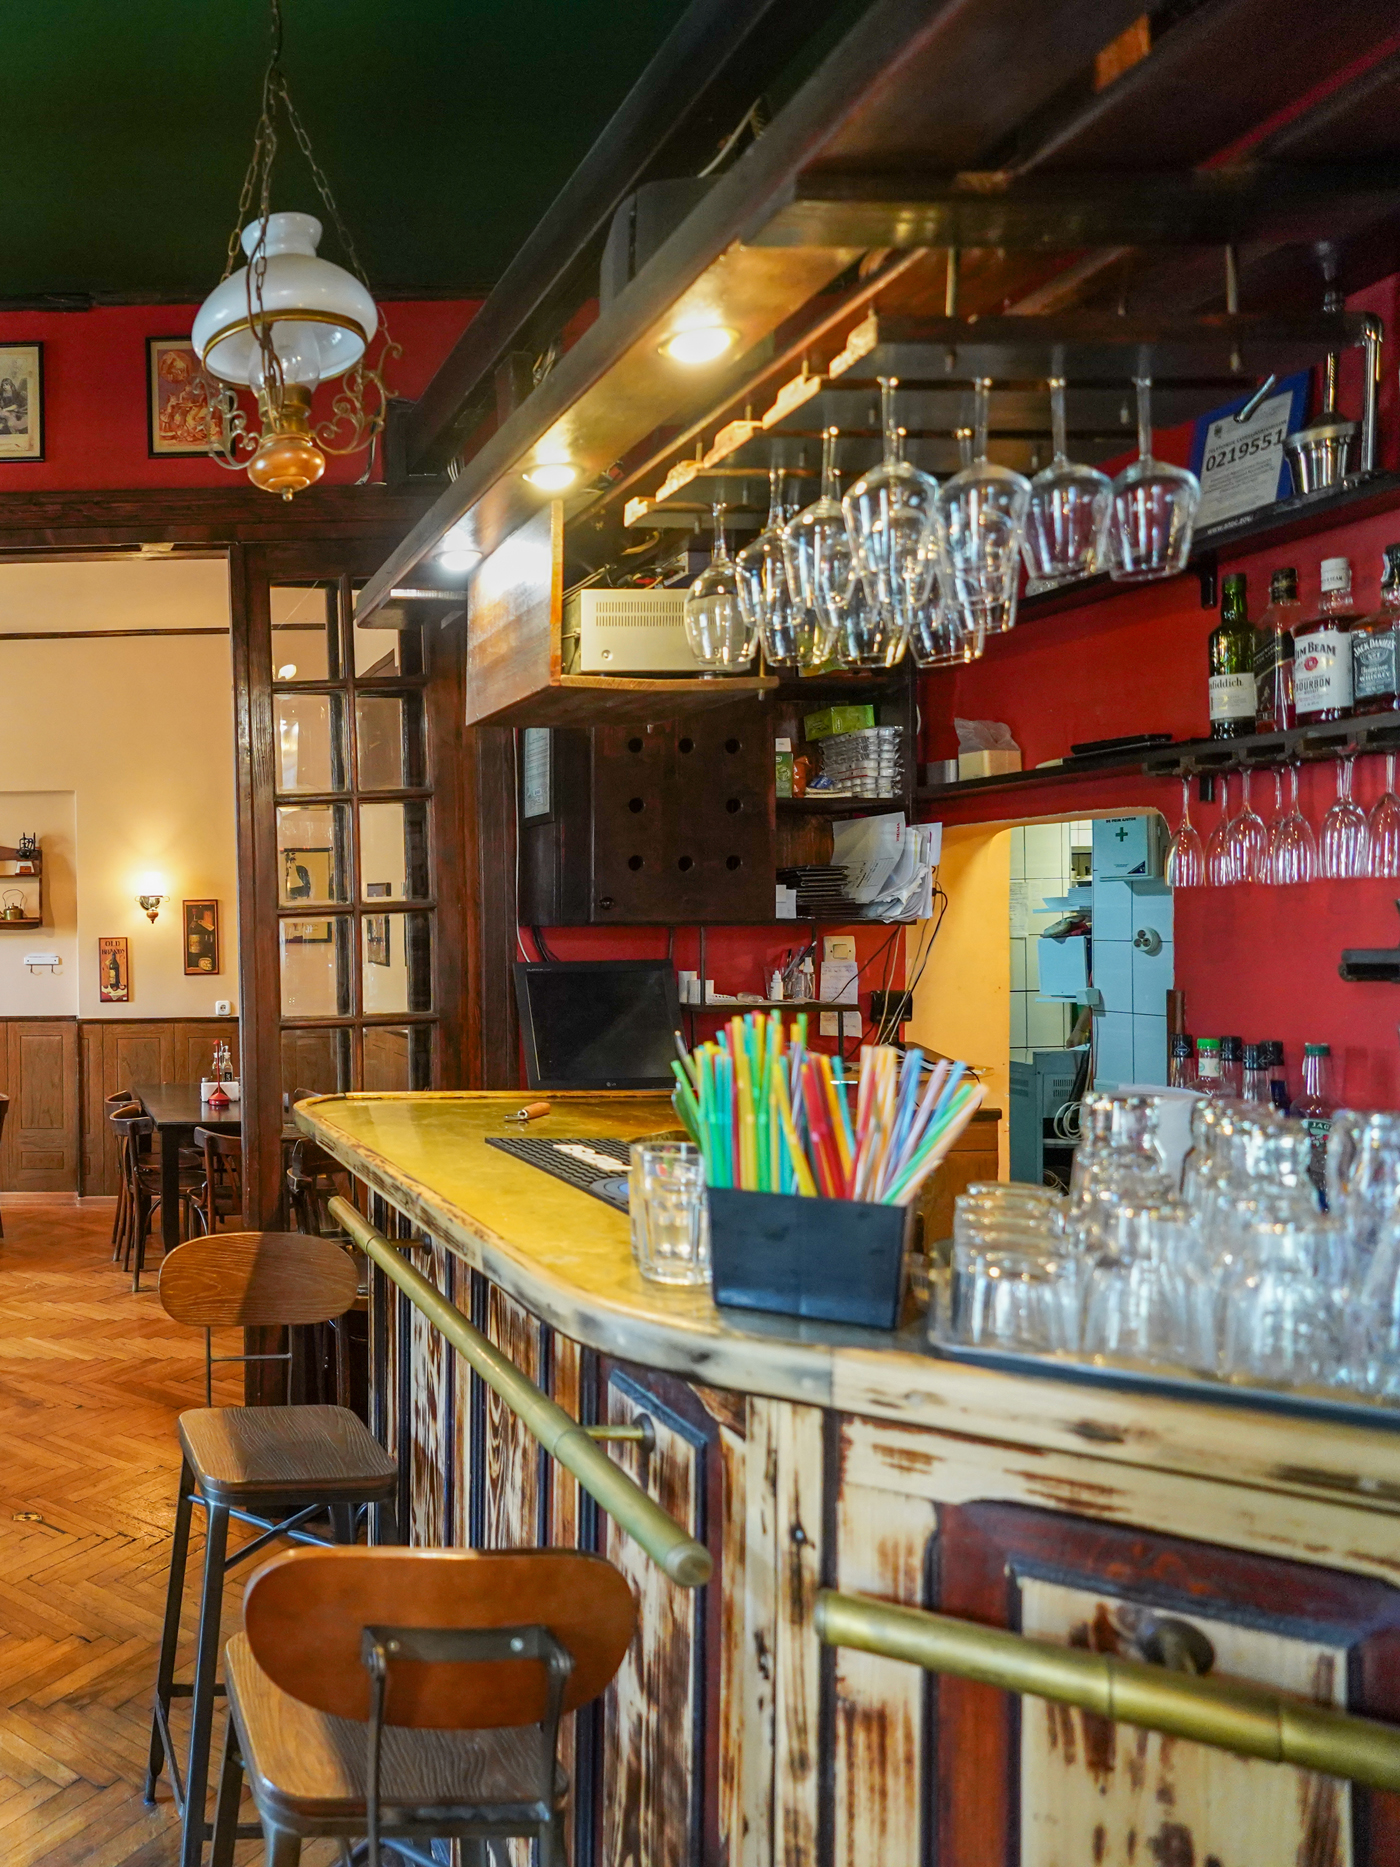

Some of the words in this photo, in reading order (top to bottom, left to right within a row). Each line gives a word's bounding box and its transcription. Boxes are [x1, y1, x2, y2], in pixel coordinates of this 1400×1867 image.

[1205, 428, 1284, 472] 0219551
[1307, 641, 1337, 657] BEAM
[1353, 642, 1370, 658] JACK
